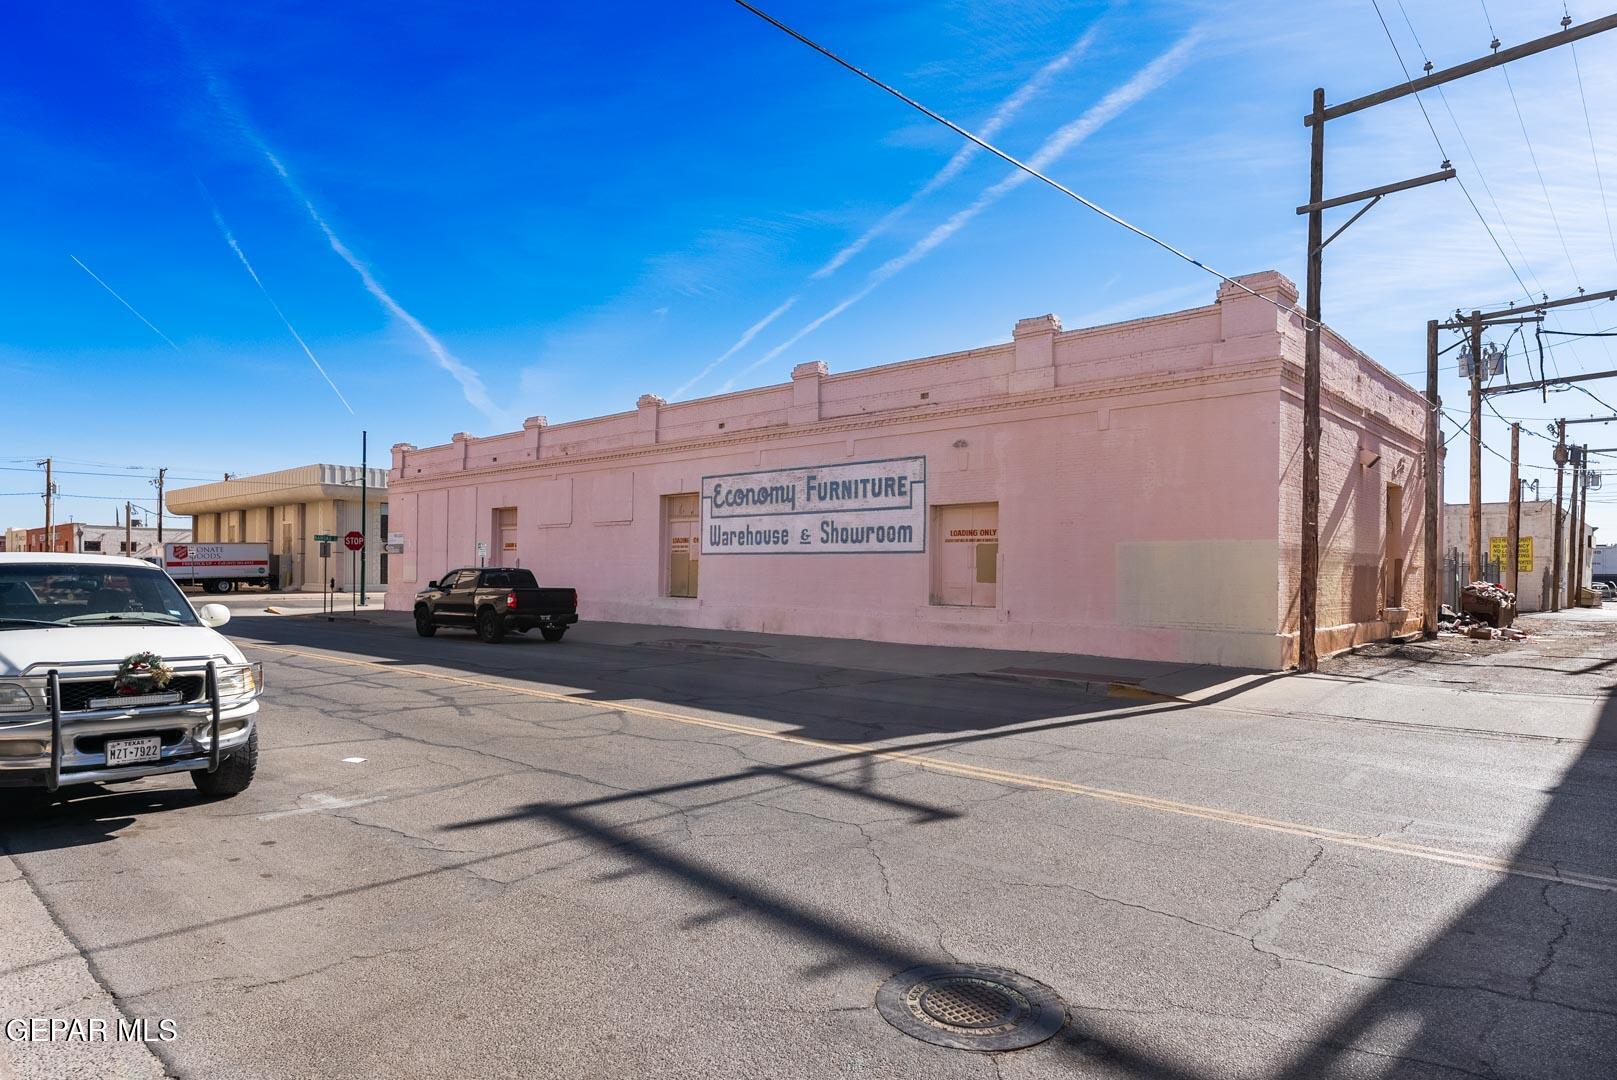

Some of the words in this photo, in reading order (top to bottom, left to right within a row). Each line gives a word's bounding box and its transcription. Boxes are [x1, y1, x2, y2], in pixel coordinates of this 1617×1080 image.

[713, 483, 796, 511] Economy
[806, 475, 908, 501] FURNITURE
[709, 524, 789, 547] Warehouse
[799, 528, 812, 545] &
[820, 520, 913, 544] Showroom
[950, 529, 978, 537] LOADING
[980, 528, 998, 536] ONLY
[345, 537, 364, 545] STOP
[124, 739, 145, 747] TEXAS
